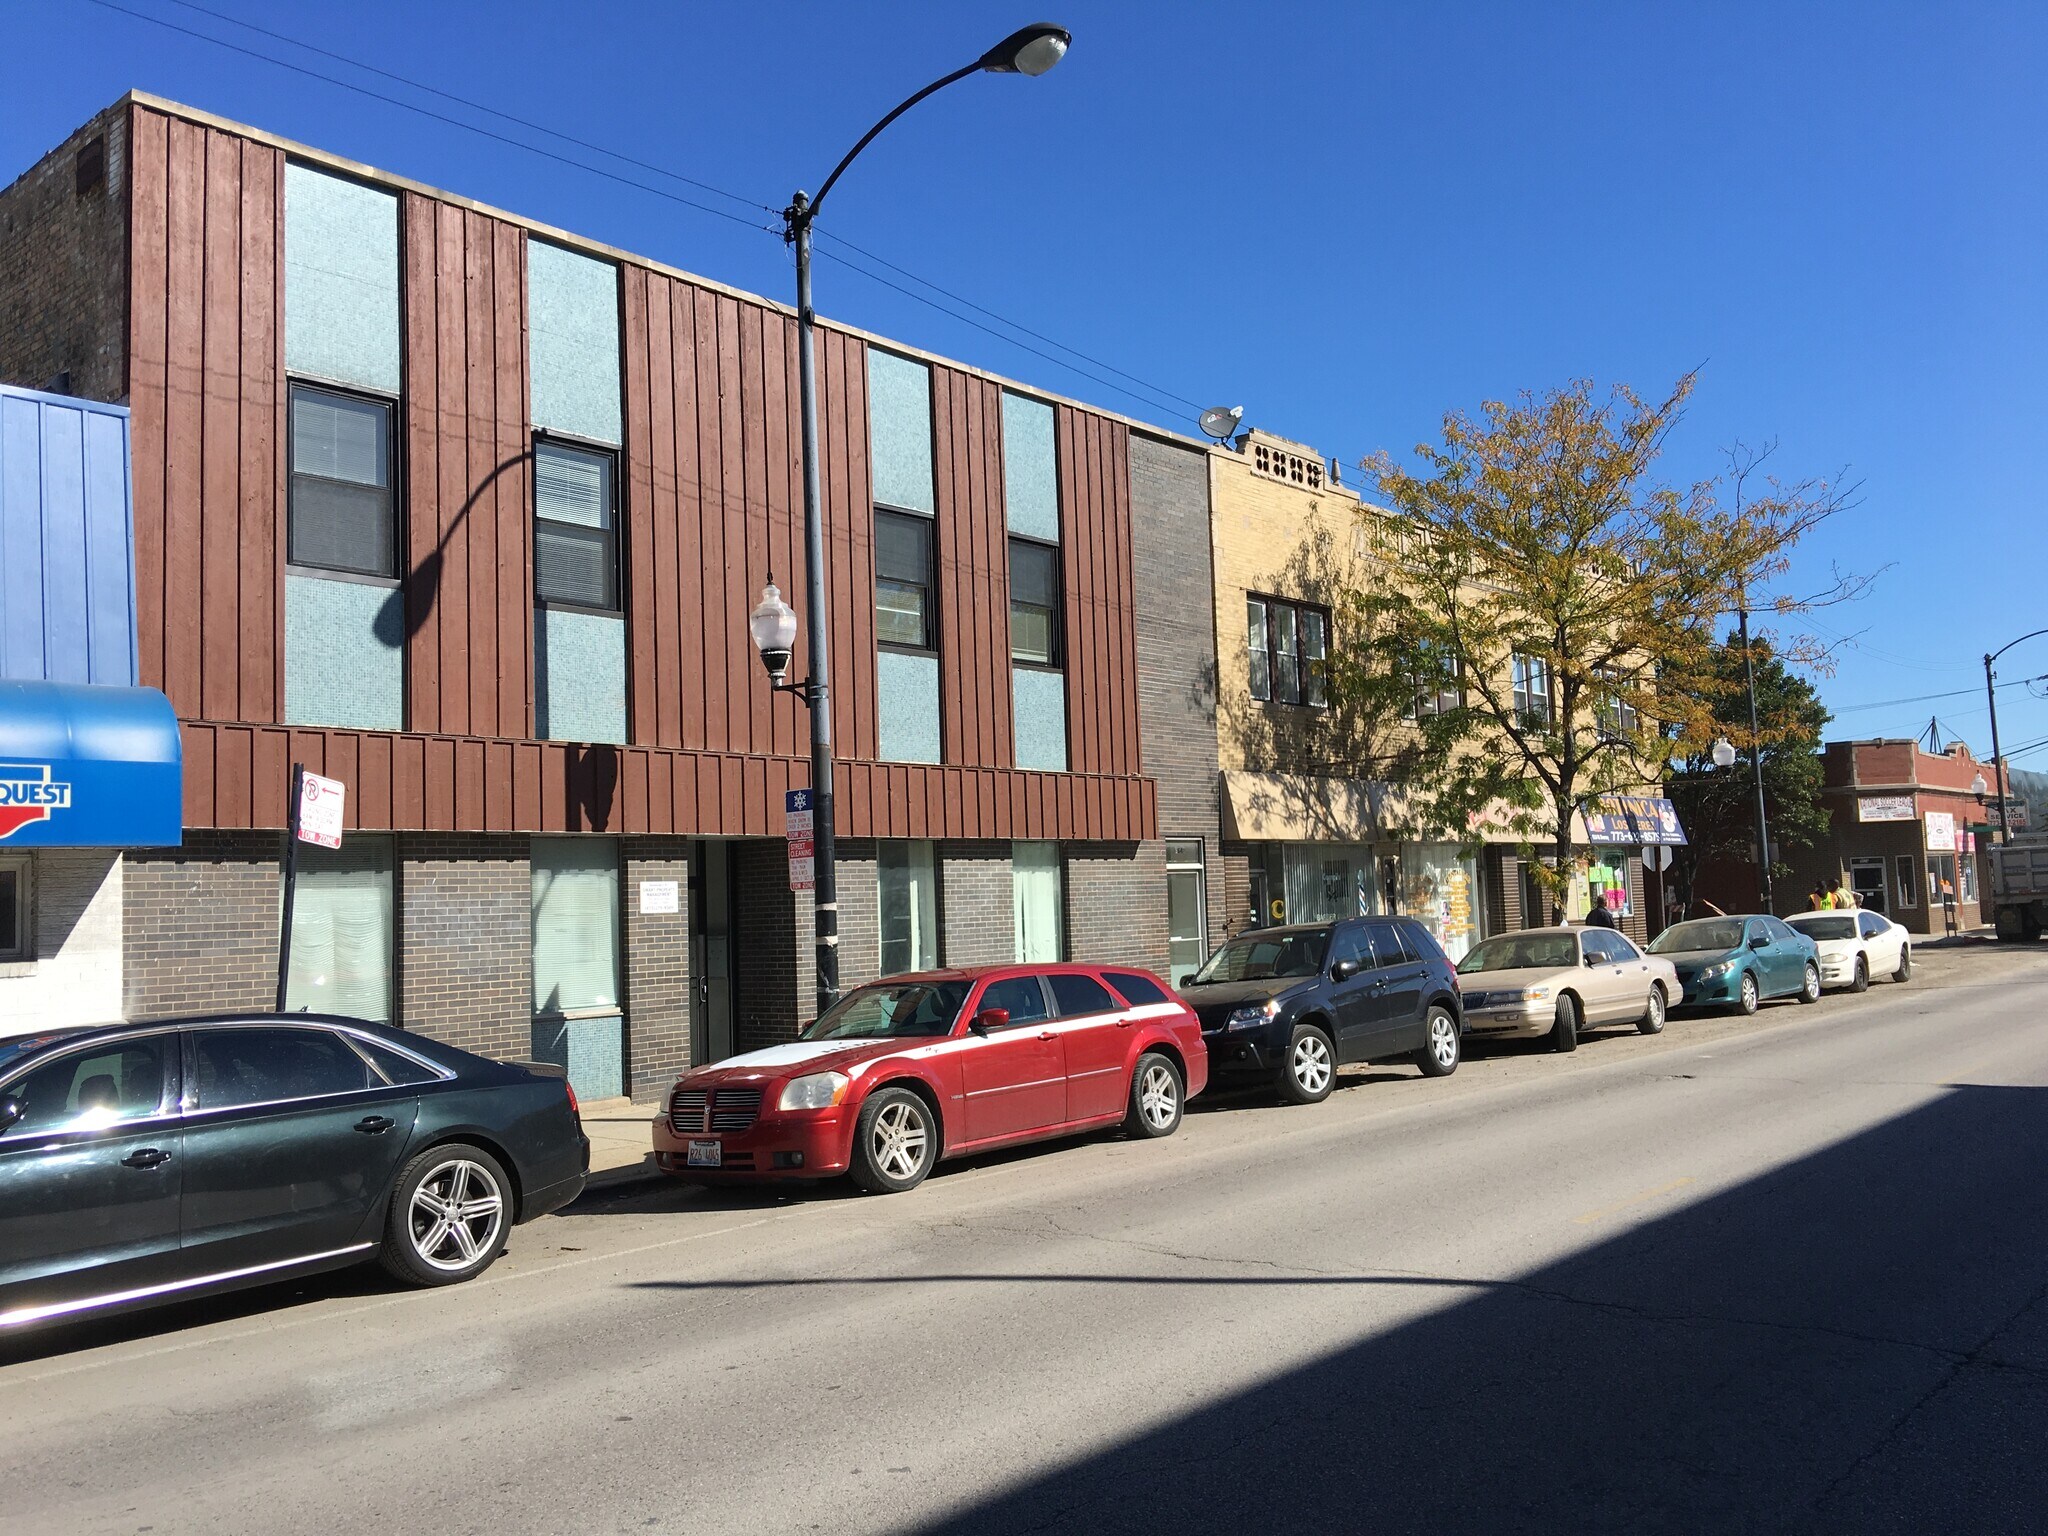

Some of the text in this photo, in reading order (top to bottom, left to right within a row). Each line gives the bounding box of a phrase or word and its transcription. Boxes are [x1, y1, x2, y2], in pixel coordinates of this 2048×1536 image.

[0, 783, 69, 805] QUEST
[1990, 812, 2024, 820] SEVICE
[302, 829, 337, 846] TOW ZONE
[791, 849, 812, 857] CLEANING
